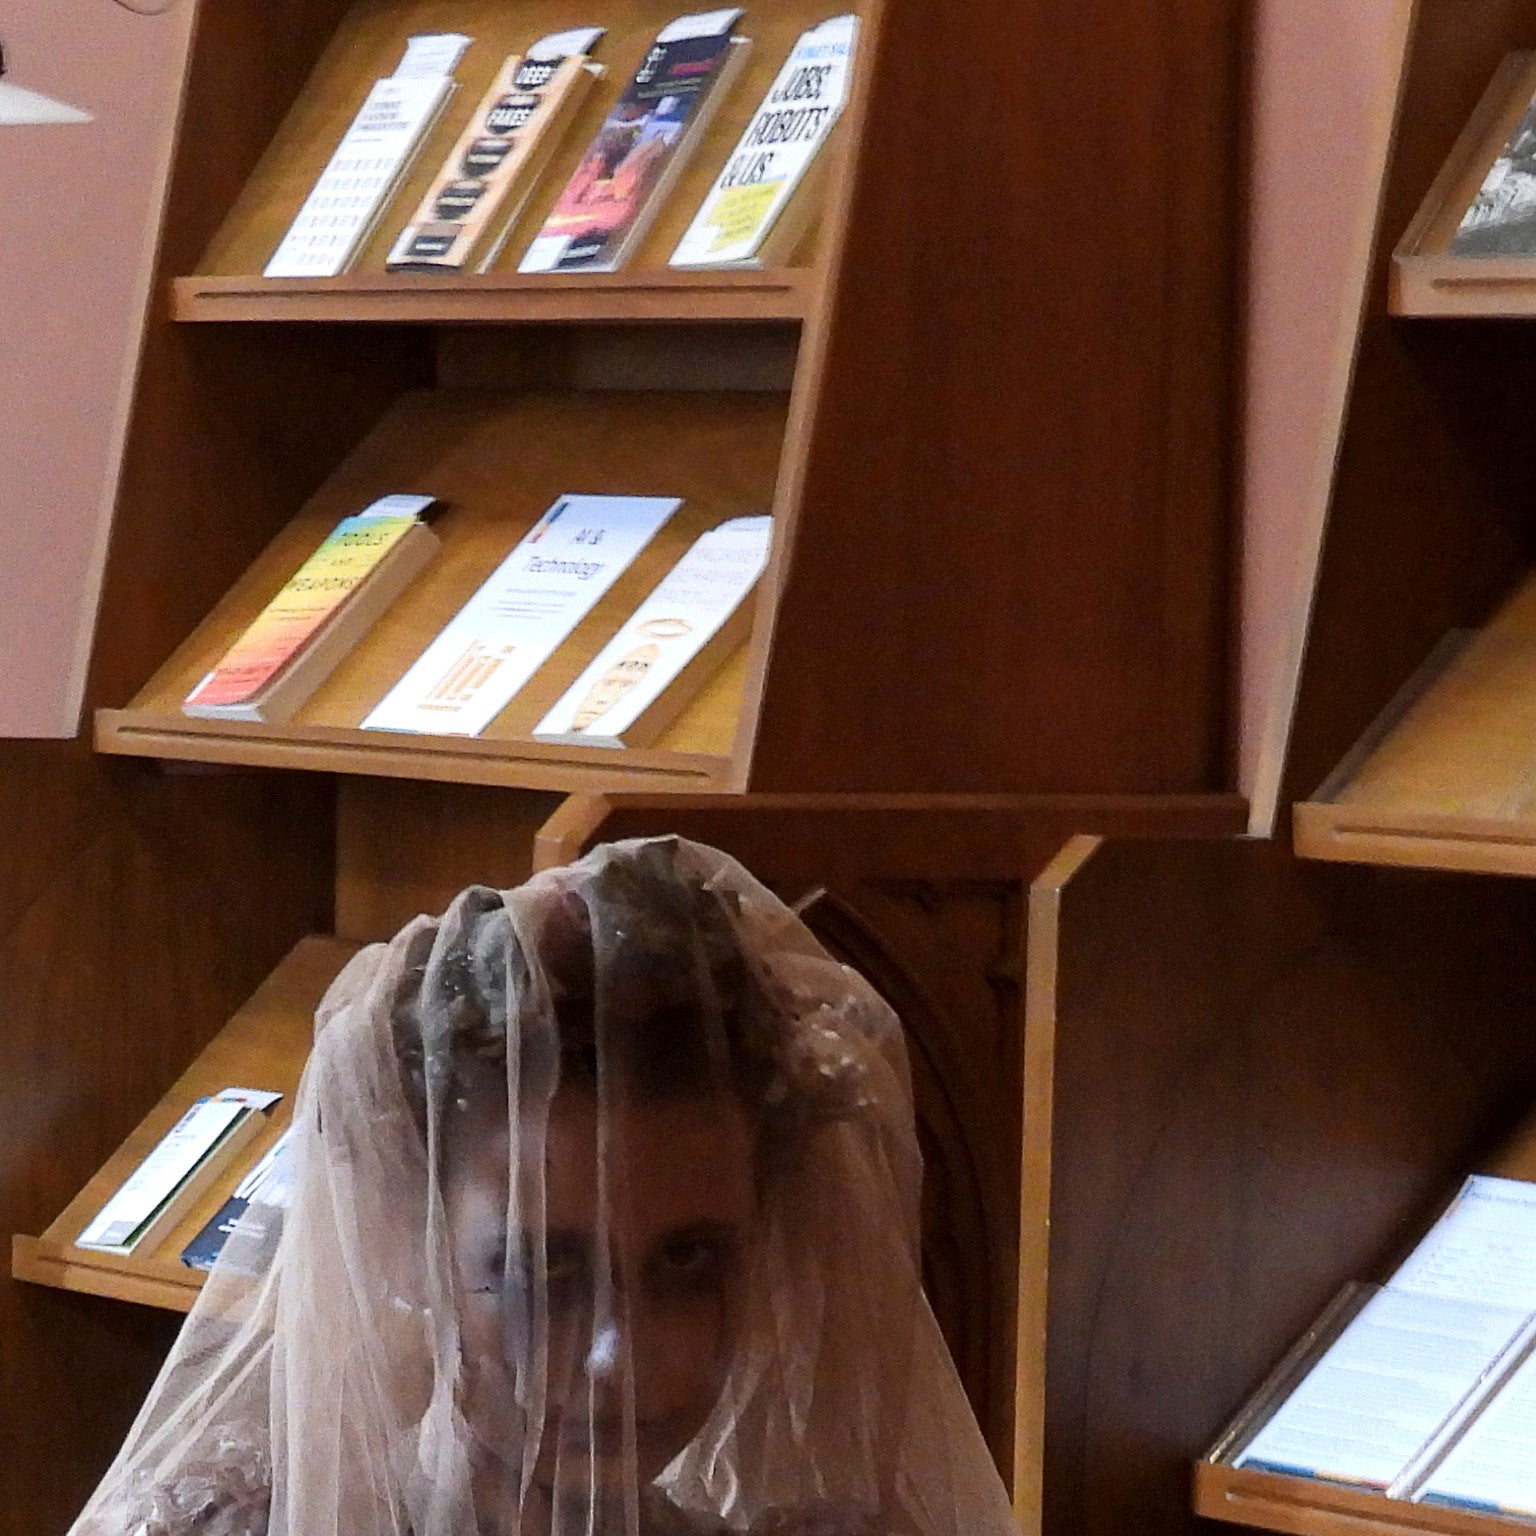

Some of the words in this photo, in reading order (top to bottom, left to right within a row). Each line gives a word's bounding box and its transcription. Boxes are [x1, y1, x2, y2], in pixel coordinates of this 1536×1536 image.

[744, 106, 829, 148] ROBOTS
[738, 150, 775, 186] US
[527, 556, 606, 580] Technology
